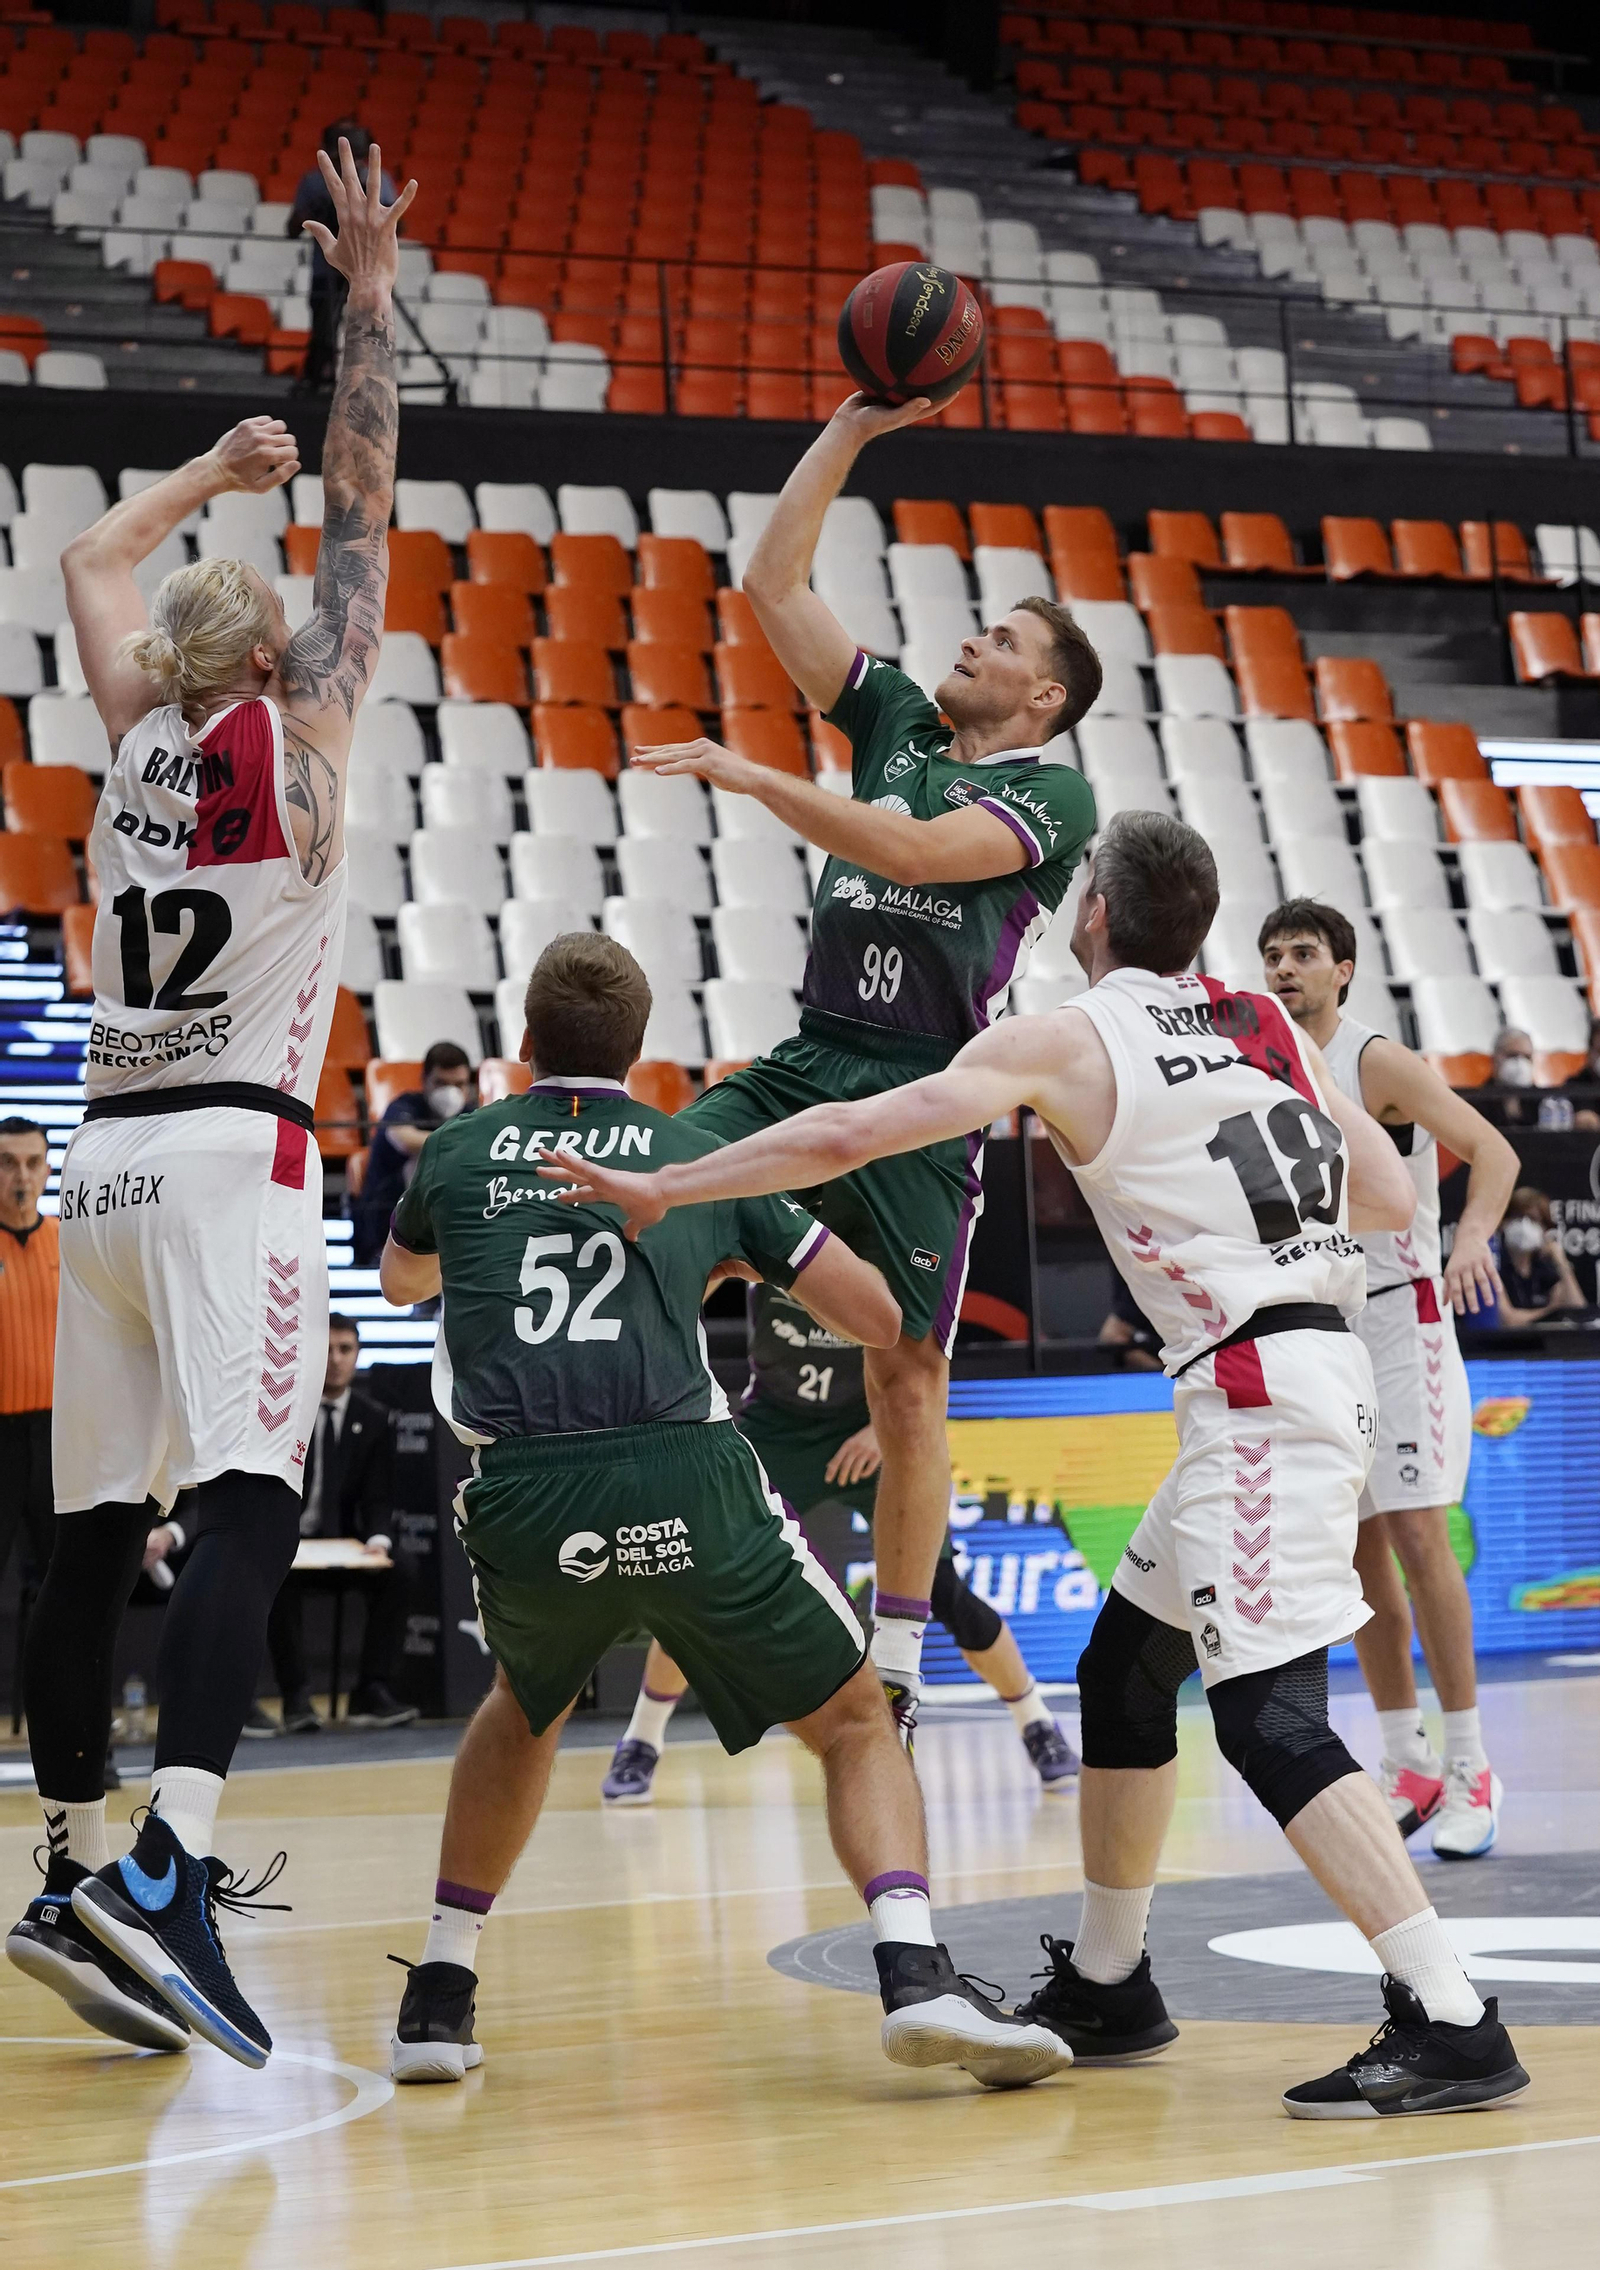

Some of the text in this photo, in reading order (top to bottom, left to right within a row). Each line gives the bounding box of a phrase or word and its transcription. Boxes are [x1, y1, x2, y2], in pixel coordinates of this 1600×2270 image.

[905, 283, 934, 337] endesa
[950, 791, 974, 805] endes
[953, 785, 968, 795] liga
[113, 802, 198, 850] bbk
[831, 875, 963, 922] 2020 MÁLAGA
[877, 903, 962, 931] EUROPEAN CAPITAL OF SPORT
[113, 885, 232, 1011] 12
[858, 943, 903, 1004] 99
[490, 1125, 653, 1162] GERUN
[1205, 1098, 1344, 1244] 18
[914, 1256, 932, 1267] acb
[514, 1231, 626, 1345] 52
[797, 1363, 834, 1403] 21
[616, 1517, 689, 1545] COSTA
[616, 1539, 692, 1562] DEL SOL
[617, 1556, 695, 1577] MÁLAGA
[1195, 1593, 1212, 1605] acb
